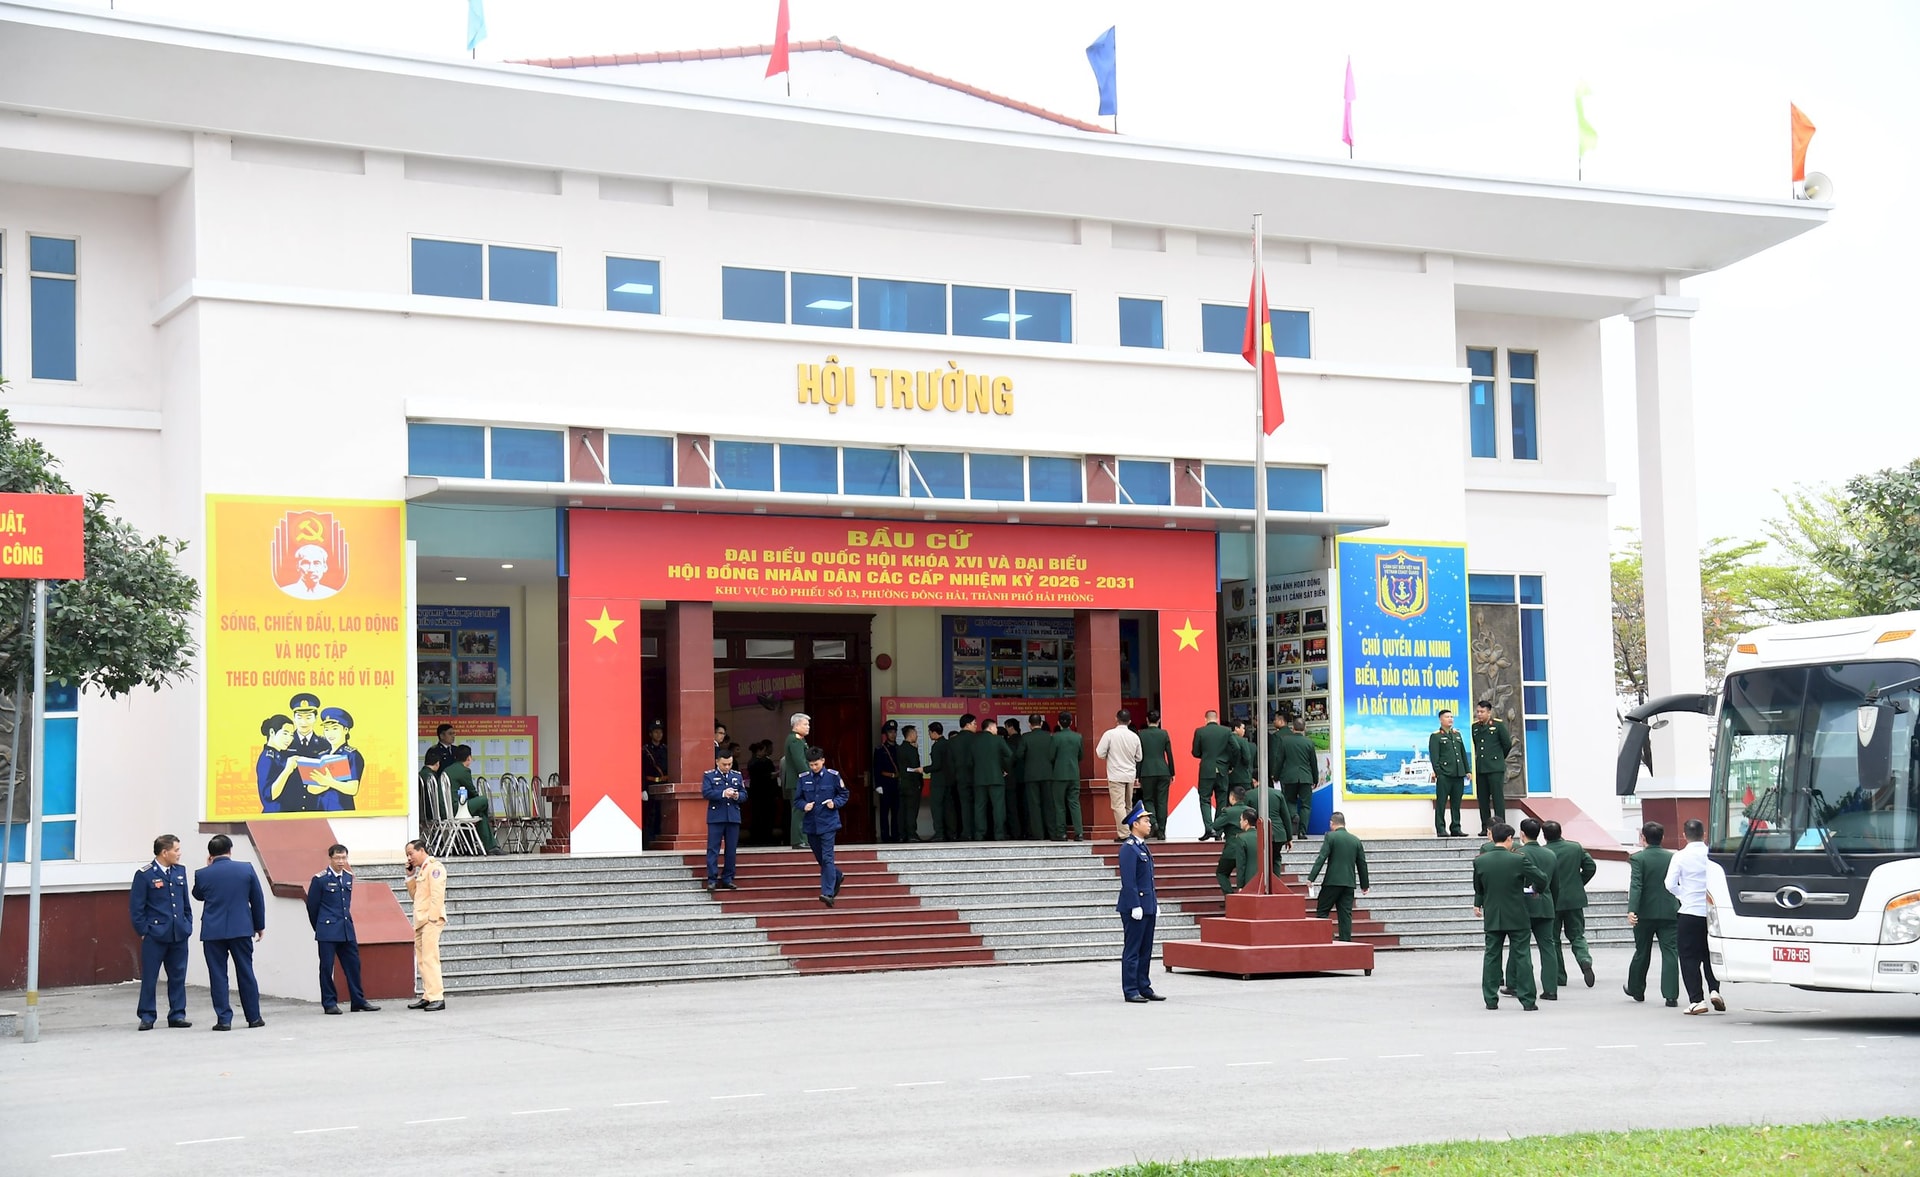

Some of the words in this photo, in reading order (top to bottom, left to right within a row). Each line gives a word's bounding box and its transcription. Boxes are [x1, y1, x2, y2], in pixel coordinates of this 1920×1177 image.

[797, 355, 855, 414] HỘI
[870, 360, 1014, 415] TRƯỜNG
[847, 526, 914, 548] BẦU
[926, 529, 973, 549] CỬ
[2, 541, 43, 566] CÔNG
[725, 548, 757, 564] ĐẠI
[763, 546, 805, 563] BIỂU
[811, 549, 861, 565] QUỐC
[866, 551, 896, 568] HỘI
[902, 553, 949, 568] KHÓA
[955, 556, 982, 569] XVI
[988, 554, 1010, 569] VÀ
[1015, 557, 1043, 572] ĐẠI
[1049, 554, 1087, 571] BIỂU
[668, 563, 700, 581] HỘI
[706, 563, 759, 580] ĐỒNG
[765, 567, 817, 582] NHÂN
[823, 568, 861, 583] DÂN
[867, 569, 903, 584] CÁC
[908, 568, 944, 585] CẤP
[950, 572, 1007, 588] NHIỆM
[1012, 572, 1034, 587] KỲ
[1039, 575, 1080, 588] 2026
[1096, 577, 1135, 589] 2031
[1294, 580, 1306, 589] HOẠT
[1307, 578, 1321, 588] ĐỘNG
[715, 586, 741, 595] KHU
[744, 586, 768, 597] VỰC
[771, 586, 788, 597] BỎ
[790, 585, 825, 597] PHIẾU
[828, 585, 843, 598] SỐ
[846, 589, 859, 599] 13,
[862, 588, 909, 600] PHƯỜNG
[911, 589, 943, 600] ĐÔNG
[946, 589, 969, 601] HẢI,
[971, 590, 1008, 601] THÀNH
[1011, 590, 1034, 601] PHỐ
[1036, 592, 1055, 602] HẢI
[1057, 592, 1094, 602] PHÒNG
[1282, 594, 1288, 602] 11
[1289, 591, 1303, 600] CẢNH
[1304, 589, 1313, 599] SÁT
[221, 610, 260, 632] SỐNG,
[264, 610, 302, 632] CHIẾN
[306, 610, 335, 633] ĐẤU,
[339, 616, 361, 632] LAO
[365, 614, 399, 635] ĐỘNG
[275, 640, 291, 659] VÀ
[295, 643, 321, 662] HỌC
[324, 640, 348, 662] TẬP
[1362, 632, 1380, 656] CHỦ
[1382, 633, 1412, 658] QUYỀN
[1414, 640, 1426, 657] AN
[1428, 640, 1451, 658] NINH
[226, 671, 258, 687] THEO
[262, 669, 305, 687] GƯƠNG
[309, 667, 335, 687] BÁC
[339, 665, 355, 687] HỒ
[359, 667, 370, 686] VĨ
[374, 670, 395, 690] ĐẠI
[1355, 661, 1380, 688] BIỂN,
[1381, 662, 1400, 686] ĐẢO
[1402, 663, 1420, 686] CỦA
[1422, 662, 1433, 687] TỔ
[1435, 664, 1459, 689] QUỐC
[1357, 693, 1368, 715] LÀ
[1371, 691, 1388, 716] BẤT
[1390, 692, 1408, 716] KHẢ
[1410, 695, 1431, 716] XÂM
[1768, 924, 1814, 937] THACO
[1774, 948, 1809, 961] TK-78-05
